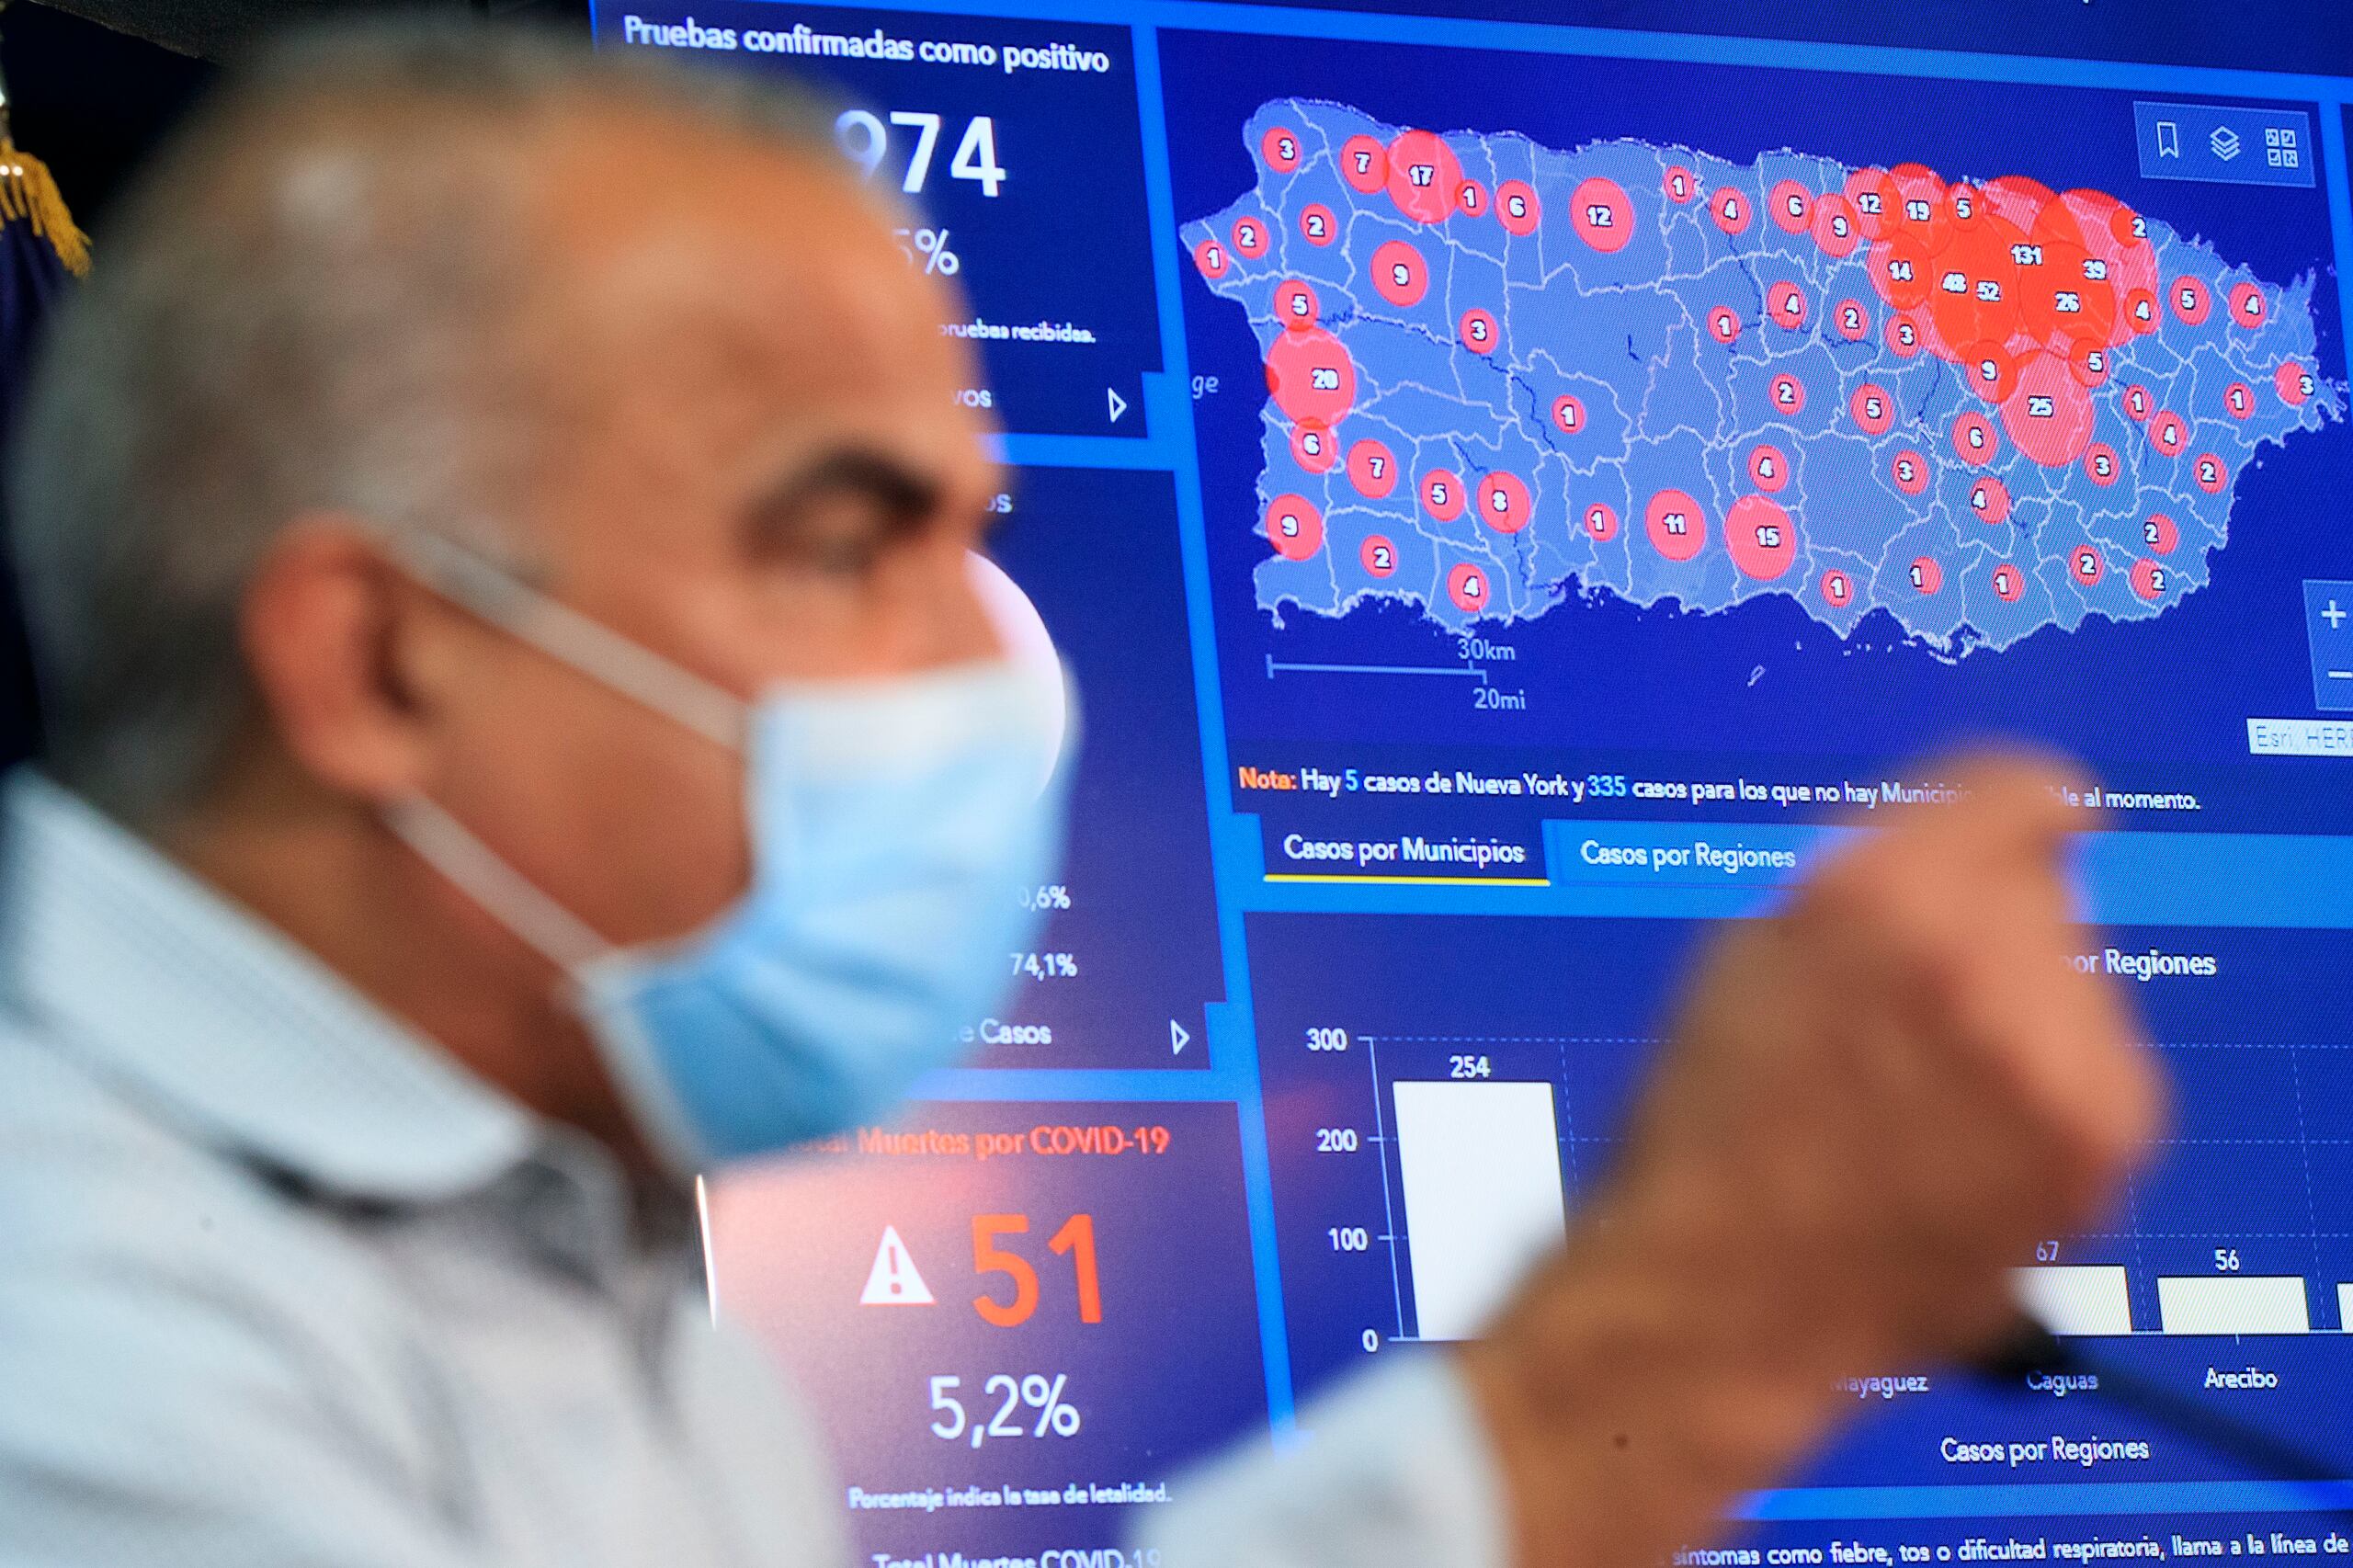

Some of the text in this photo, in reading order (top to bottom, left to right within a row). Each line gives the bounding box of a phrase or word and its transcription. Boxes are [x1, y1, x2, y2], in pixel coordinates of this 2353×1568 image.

[624, 15, 1110, 73] Pruebas confirmadas como positivo
[1279, 139, 1295, 160] 3
[1354, 153, 1370, 174] 7
[1409, 165, 1434, 187] 17
[1672, 176, 1685, 197] 1
[1462, 187, 1476, 208] 1
[1508, 197, 1525, 217] 6
[1787, 196, 1803, 216] 6
[1858, 193, 1882, 214] 12
[1586, 206, 1613, 227] 12
[1723, 199, 1738, 220] 4
[1905, 200, 1931, 222] 19
[1955, 199, 1972, 219] 5
[1307, 215, 1324, 236] 2
[1832, 216, 1848, 236] 9
[2131, 217, 2147, 238] 2
[1239, 226, 1256, 247] 2
[1206, 248, 1221, 269] 1
[2010, 244, 2043, 267] 131
[1392, 265, 1409, 286] 9
[1888, 261, 1913, 281] 14
[1975, 280, 2001, 302] 52
[2180, 290, 2195, 309] 5
[1291, 294, 1309, 315] 5
[1785, 294, 1801, 315] 4
[2054, 292, 2081, 312] 26
[2134, 300, 2151, 320] 4
[2245, 295, 2260, 315] 4
[1717, 316, 1732, 336] 1
[1843, 308, 1859, 329] 2
[1011, 321, 1097, 344] recibidas.
[1470, 320, 1487, 341] 3
[1898, 324, 1915, 345] 3
[1981, 360, 1997, 381] 9
[2087, 351, 2104, 371] 5
[1311, 369, 1339, 390] 20
[2299, 375, 2315, 395] 3
[1778, 382, 1794, 403] 2
[2131, 392, 2143, 412] 1
[2230, 390, 2244, 410] 1
[1560, 405, 1575, 426] 1
[1865, 398, 1881, 419] 5
[2028, 396, 2054, 417] 25
[1302, 434, 1321, 455] 6
[1969, 427, 1984, 448] 6
[2163, 425, 2177, 445] 4
[1369, 457, 1384, 479] 7
[1758, 458, 1774, 478] 4
[1897, 460, 1914, 482] 3
[2095, 456, 2111, 476] 3
[2200, 461, 2216, 482] 2
[1430, 483, 1447, 505] 5
[1492, 491, 1508, 512] 8
[1972, 489, 1987, 509] 4
[1280, 515, 1299, 537] 9
[1590, 510, 1604, 531] 1
[1663, 513, 1687, 534] 11
[1756, 527, 1780, 547] 15
[2143, 523, 2159, 543] 2
[1373, 547, 1391, 568] 2
[2079, 554, 2096, 574] 2
[1462, 576, 1480, 597] 4
[1829, 576, 1844, 597] 1
[1909, 566, 1923, 586] 1
[1994, 574, 2008, 594] 1
[2151, 570, 2165, 590] 2
[1457, 638, 1516, 662] 30km
[1473, 687, 1526, 710] 20mi
[1238, 767, 1298, 790] Nota:
[1301, 768, 1341, 798] Hay
[1345, 768, 1358, 792] 5
[1363, 774, 1421, 793] casos
[1425, 771, 1452, 794] de
[1455, 771, 1522, 795] Nueva
[1523, 773, 1568, 797] York
[1571, 780, 1585, 803] y
[1587, 774, 1627, 797] 335
[1631, 780, 1688, 799] casos
[1691, 784, 1735, 805] para
[1738, 778, 1768, 801] los
[1771, 784, 1811, 807] que
[1814, 786, 1840, 802] no
[1844, 780, 1878, 809] hay
[2084, 787, 2101, 808] al
[2105, 791, 2202, 810] momento.
[1283, 834, 1525, 869] Casos por Municipios
[1581, 840, 1796, 874] Casos por Regiones
[1009, 951, 1078, 983] 74,1%
[2104, 948, 2217, 982] Regiones
[979, 1017, 1052, 1045] Casos
[1306, 1028, 1347, 1051] 300
[1449, 1055, 1491, 1079] 254
[857, 1127, 971, 1155] Muertes
[974, 1131, 1024, 1162] por
[1029, 1125, 1171, 1156] COVID-19
[1316, 1129, 1358, 1153] 200
[1327, 1227, 1368, 1251] 100
[2035, 1240, 2060, 1262] 67
[2214, 1248, 2240, 1272] 56
[972, 1212, 1102, 1328] 51
[1361, 1329, 1378, 1353] 0
[2205, 1367, 2278, 1391] Arecibo
[929, 1372, 1081, 1449] 5,2%
[1940, 1436, 2149, 1468] Casos por Regiones
[847, 1481, 1173, 1513] Porcentaje indica la tasa de letalidad.
[1767, 1547, 1824, 1565] como
[1829, 1540, 1893, 1567] fiebre,
[1898, 1544, 1932, 1563] tos
[1936, 1545, 1952, 1562] o
[1957, 1537, 2046, 1562] dificultad
[2052, 1535, 2165, 1564] respiratoria,
[2171, 1534, 2222, 1558] llama
[2229, 1538, 2242, 1557] a
[2246, 1532, 2266, 1556] la
[2270, 1531, 2318, 1556] línea
[2323, 1530, 2350, 1554] de
